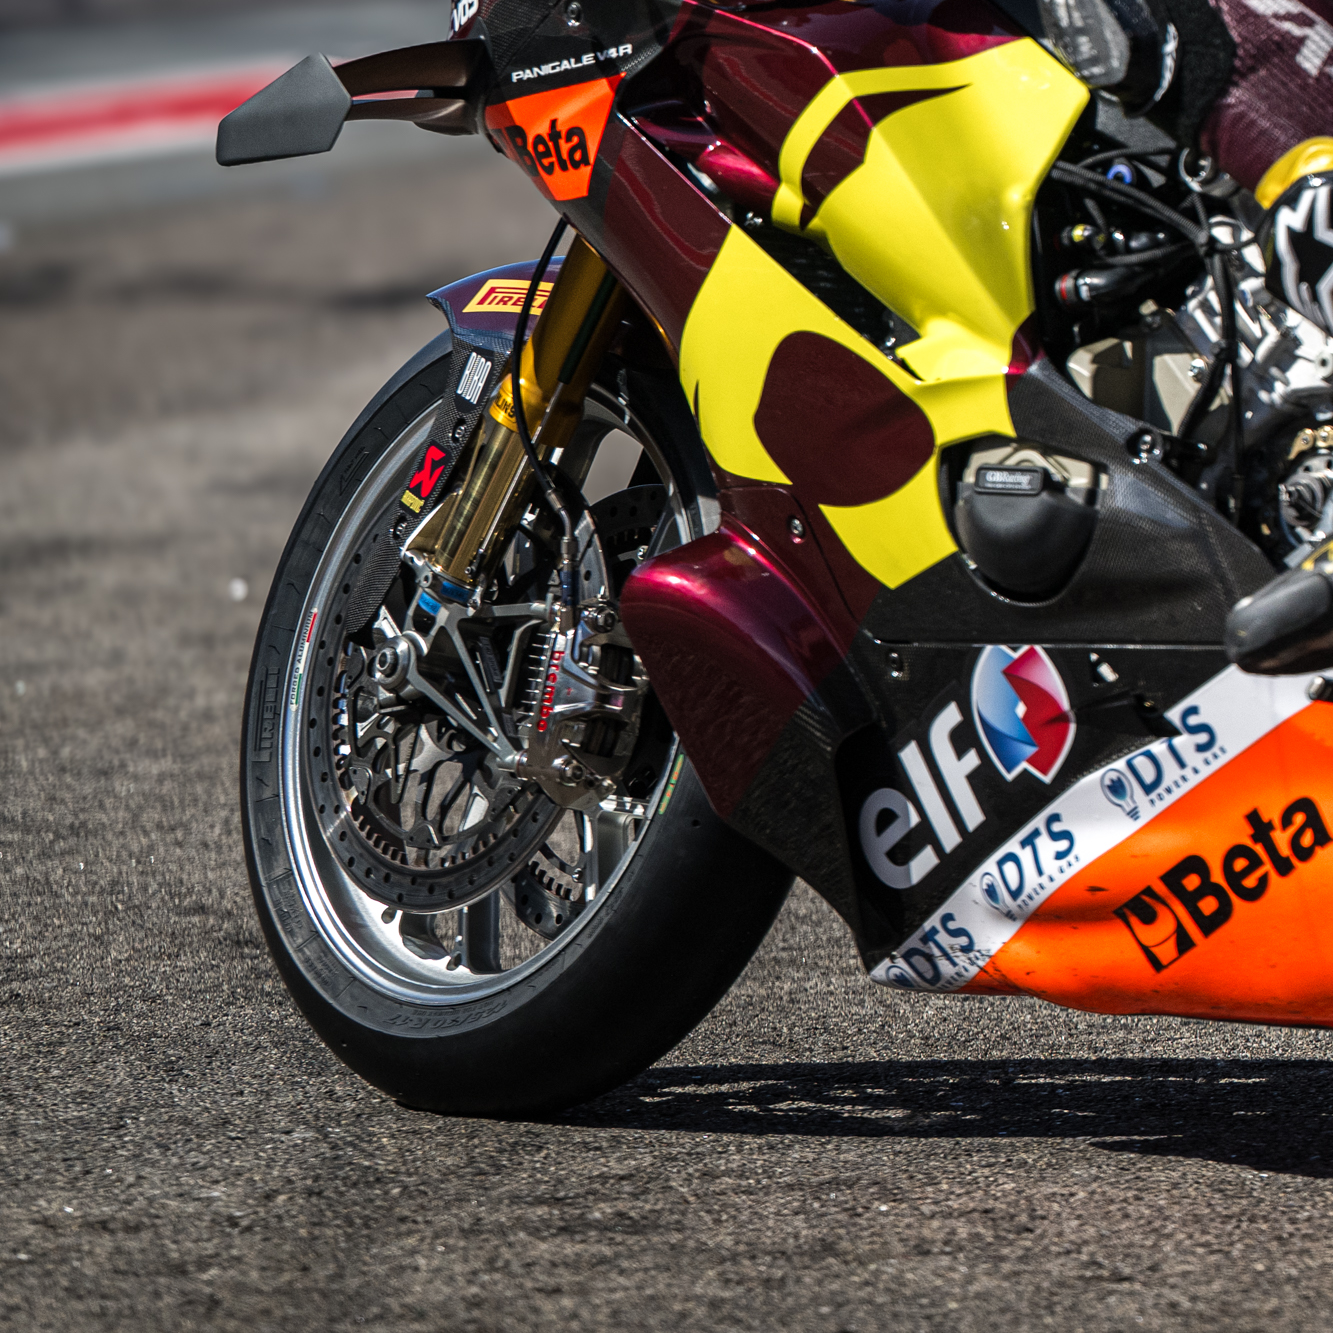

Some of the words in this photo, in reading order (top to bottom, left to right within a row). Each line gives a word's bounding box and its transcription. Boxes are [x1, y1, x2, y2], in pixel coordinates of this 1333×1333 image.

[511, 53, 596, 83] PANIGALE
[514, 119, 592, 177] Beta
[289, 667, 301, 705] FORGED
[296, 611, 315, 664] ALUMINIUM
[538, 651, 564, 732] brembo
[252, 666, 281, 763] PIRELLI
[1124, 704, 1218, 796] DTS
[859, 700, 986, 889] elf
[1148, 773, 1190, 808] POWER
[1203, 746, 1228, 767] GAS
[996, 812, 1075, 902] DTS
[901, 912, 975, 988] DTS
